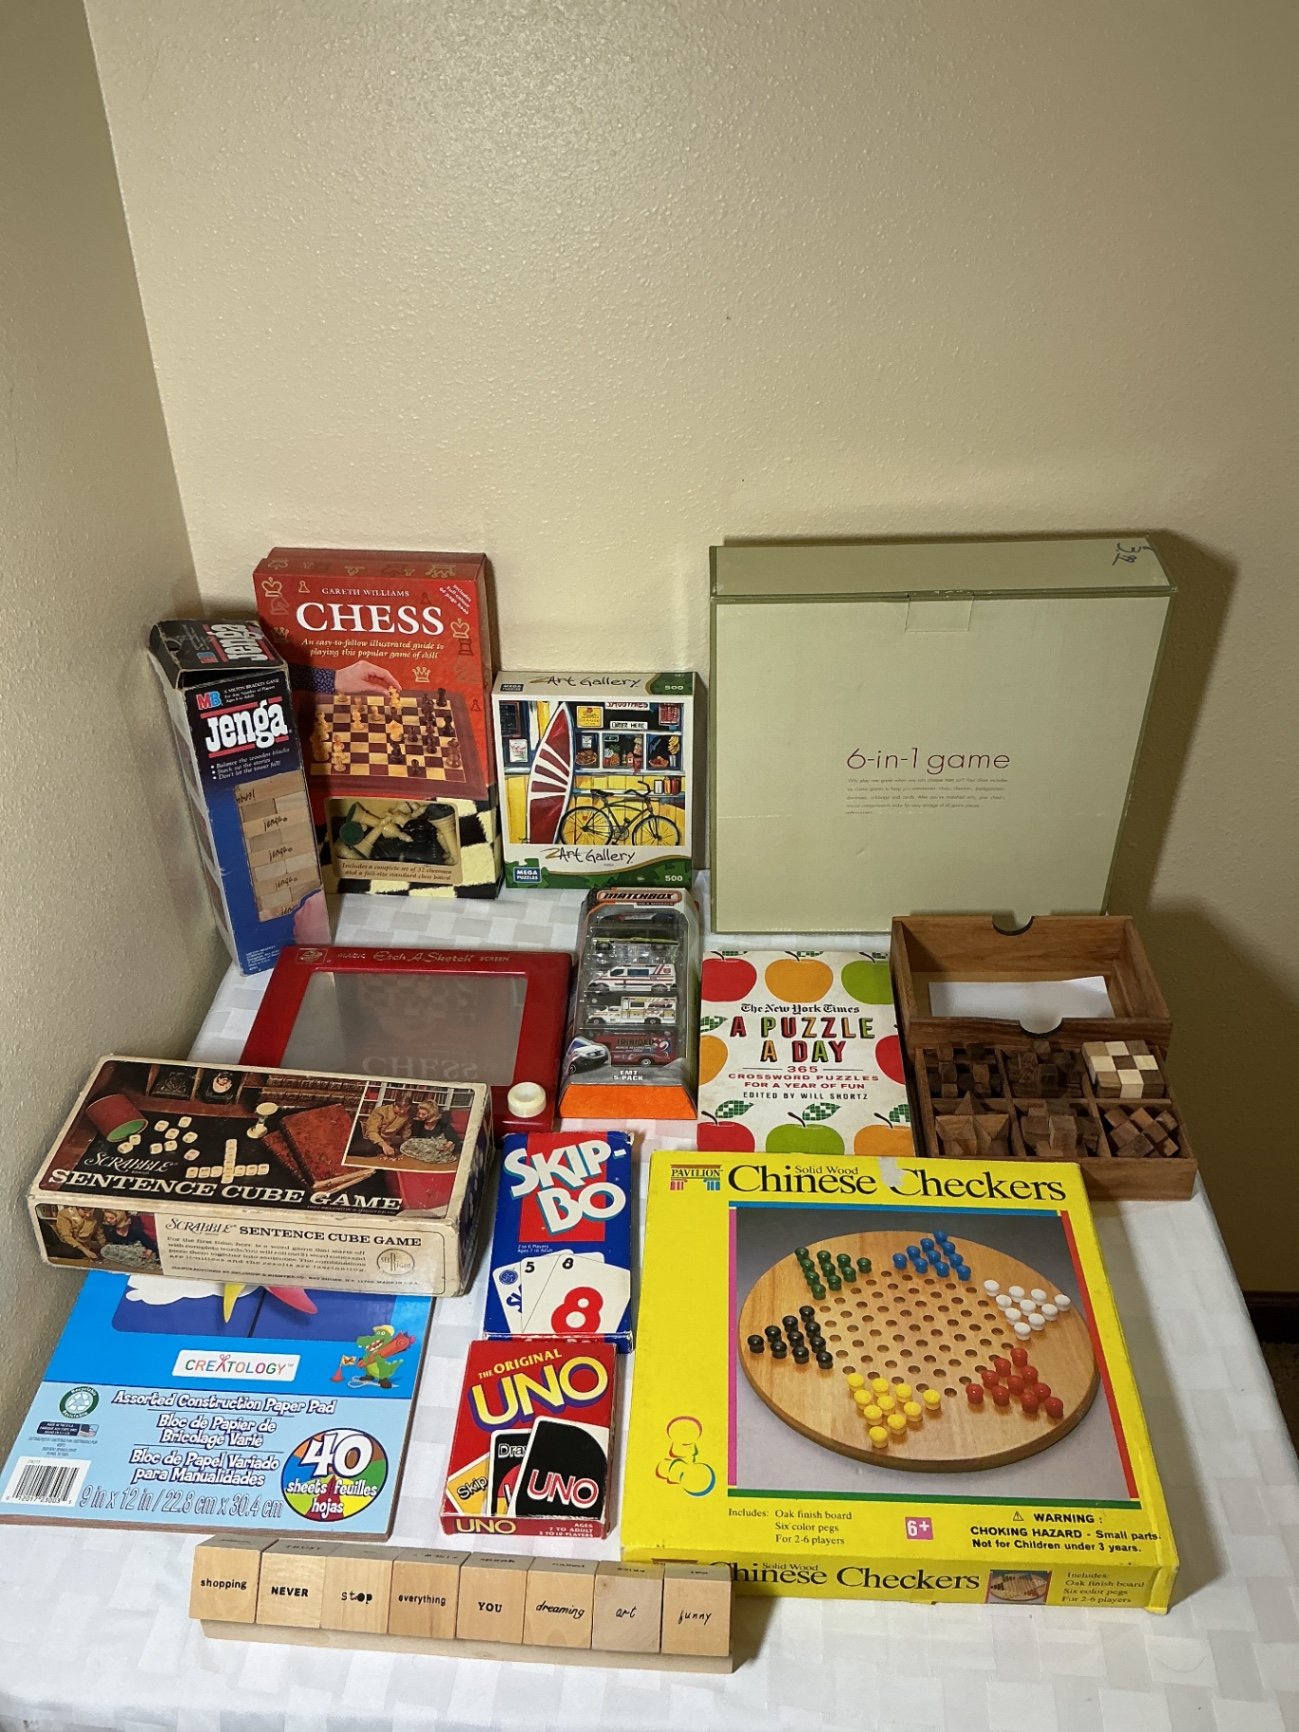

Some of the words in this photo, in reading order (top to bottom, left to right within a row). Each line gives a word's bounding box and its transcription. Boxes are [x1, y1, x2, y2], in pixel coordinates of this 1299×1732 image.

[321, 588, 360, 596] GARETH
[363, 588, 410, 597] WILLIAMS
[296, 602, 445, 636] CHESS
[211, 624, 268, 661] Jenga
[301, 638, 314, 646] An
[315, 638, 368, 649] easy-to-follow
[369, 640, 411, 648] illustrated
[412, 641, 435, 650] guide
[310, 648, 338, 657] playing
[342, 648, 356, 656] this
[358, 649, 388, 658] popular
[412, 650, 421, 660] of
[422, 650, 438, 659] skill
[547, 676, 576, 687] Art
[580, 676, 642, 688] Gallery
[196, 691, 222, 710] MB
[205, 699, 288, 752] Jenga
[847, 747, 918, 770] 6-in-1
[926, 754, 1010, 775] game
[559, 848, 583, 862] Art
[586, 848, 636, 864] Gallery
[604, 892, 674, 900] MATCHBOX
[373, 950, 406, 961] Etch
[411, 952, 423, 962] A
[428, 952, 474, 963] Sketch
[741, 1004, 763, 1014] The
[764, 1004, 790, 1013] New
[792, 1004, 822, 1015] York
[823, 1004, 860, 1014] Times
[730, 1016, 747, 1038] A
[760, 1016, 876, 1040] PUZZLE
[760, 1040, 778, 1062] A
[792, 1040, 846, 1062] DAY
[84, 1152, 171, 1172] SCRABBLE
[504, 1140, 626, 1200] SKIP-
[795, 1166, 822, 1174] Solid
[826, 1166, 859, 1176] Wood
[728, 1164, 877, 1194] Chinese
[48, 1168, 218, 1197] SENTENCE
[222, 1185, 305, 1203] CUBE
[310, 1191, 403, 1210] GAME
[537, 1182, 626, 1234] BO
[165, 1218, 232, 1234] SCRABBLE
[239, 1226, 325, 1240] SENTENCE
[328, 1232, 370, 1244] CUBE
[373, 1235, 422, 1246] GAME
[524, 1262, 535, 1273] 5
[562, 1258, 574, 1270] 8
[551, 1286, 604, 1334] 8
[185, 1356, 286, 1375] CREATOLOGY
[478, 1370, 492, 1380] THE
[493, 1348, 562, 1374] ORIGINAL
[471, 1356, 608, 1426] UNO
[112, 1390, 174, 1406] Assorted
[178, 1393, 262, 1410] Construction
[262, 1398, 306, 1414] Paper
[306, 1399, 338, 1414] Pad
[157, 1414, 188, 1429] Bloc
[190, 1415, 208, 1430] de
[212, 1416, 256, 1434] Papier
[259, 1418, 276, 1432] de
[160, 1430, 224, 1450] Bricolage
[130, 1448, 160, 1463] Bloc
[163, 1450, 181, 1465] de
[184, 1451, 226, 1470] Papel
[228, 1454, 280, 1470] Variado
[298, 1433, 374, 1478] 40
[130, 1467, 168, 1484] para
[174, 1467, 266, 1487] Manualidades
[286, 1478, 328, 1494] sheets
[333, 1478, 378, 1496] feuilles
[456, 1476, 490, 1500] Skip
[526, 1469, 599, 1509] UNO
[80, 1485, 94, 1507] 9
[90, 1486, 104, 1508] in
[106, 1491, 118, 1509] x
[120, 1488, 138, 1510] 12
[138, 1488, 153, 1510] in
[194, 1495, 216, 1514] cm
[218, 1496, 230, 1515] x
[229, 1494, 260, 1517] 30.4
[261, 1498, 283, 1518] cm
[310, 1498, 344, 1518] hojas
[728, 1508, 768, 1517] Includes:
[774, 1510, 794, 1518] Oak
[797, 1510, 822, 1519] finish
[824, 1511, 852, 1520] board
[1033, 1513, 1095, 1523] WARNING
[456, 1519, 516, 1534] UNO
[775, 1522, 790, 1530] Six
[791, 1523, 815, 1531] color
[818, 1525, 839, 1534] pegs
[907, 1520, 930, 1536] 6+
[970, 1526, 1028, 1536] CHOKING
[1032, 1528, 1082, 1538] HAZARD
[1096, 1530, 1128, 1540] Small
[1131, 1532, 1161, 1541] parts.
[776, 1534, 792, 1542] For
[794, 1535, 810, 1544] 2-6
[812, 1536, 844, 1546] players
[972, 1539, 992, 1548] Not
[995, 1540, 1010, 1549] for
[1014, 1540, 1060, 1550] Children
[1064, 1540, 1096, 1551] under
[1099, 1542, 1104, 1550] 3
[1108, 1544, 1142, 1552] years.
[762, 1562, 787, 1570] Solid
[200, 1578, 247, 1590] shopping
[836, 1567, 980, 1590] Checkers
[270, 1586, 309, 1598] NEVER
[398, 1593, 446, 1606] everything
[478, 1601, 502, 1612] YOU
[536, 1600, 586, 1620] dreaming
[616, 1606, 638, 1618] art
[678, 1611, 712, 1625] funny
